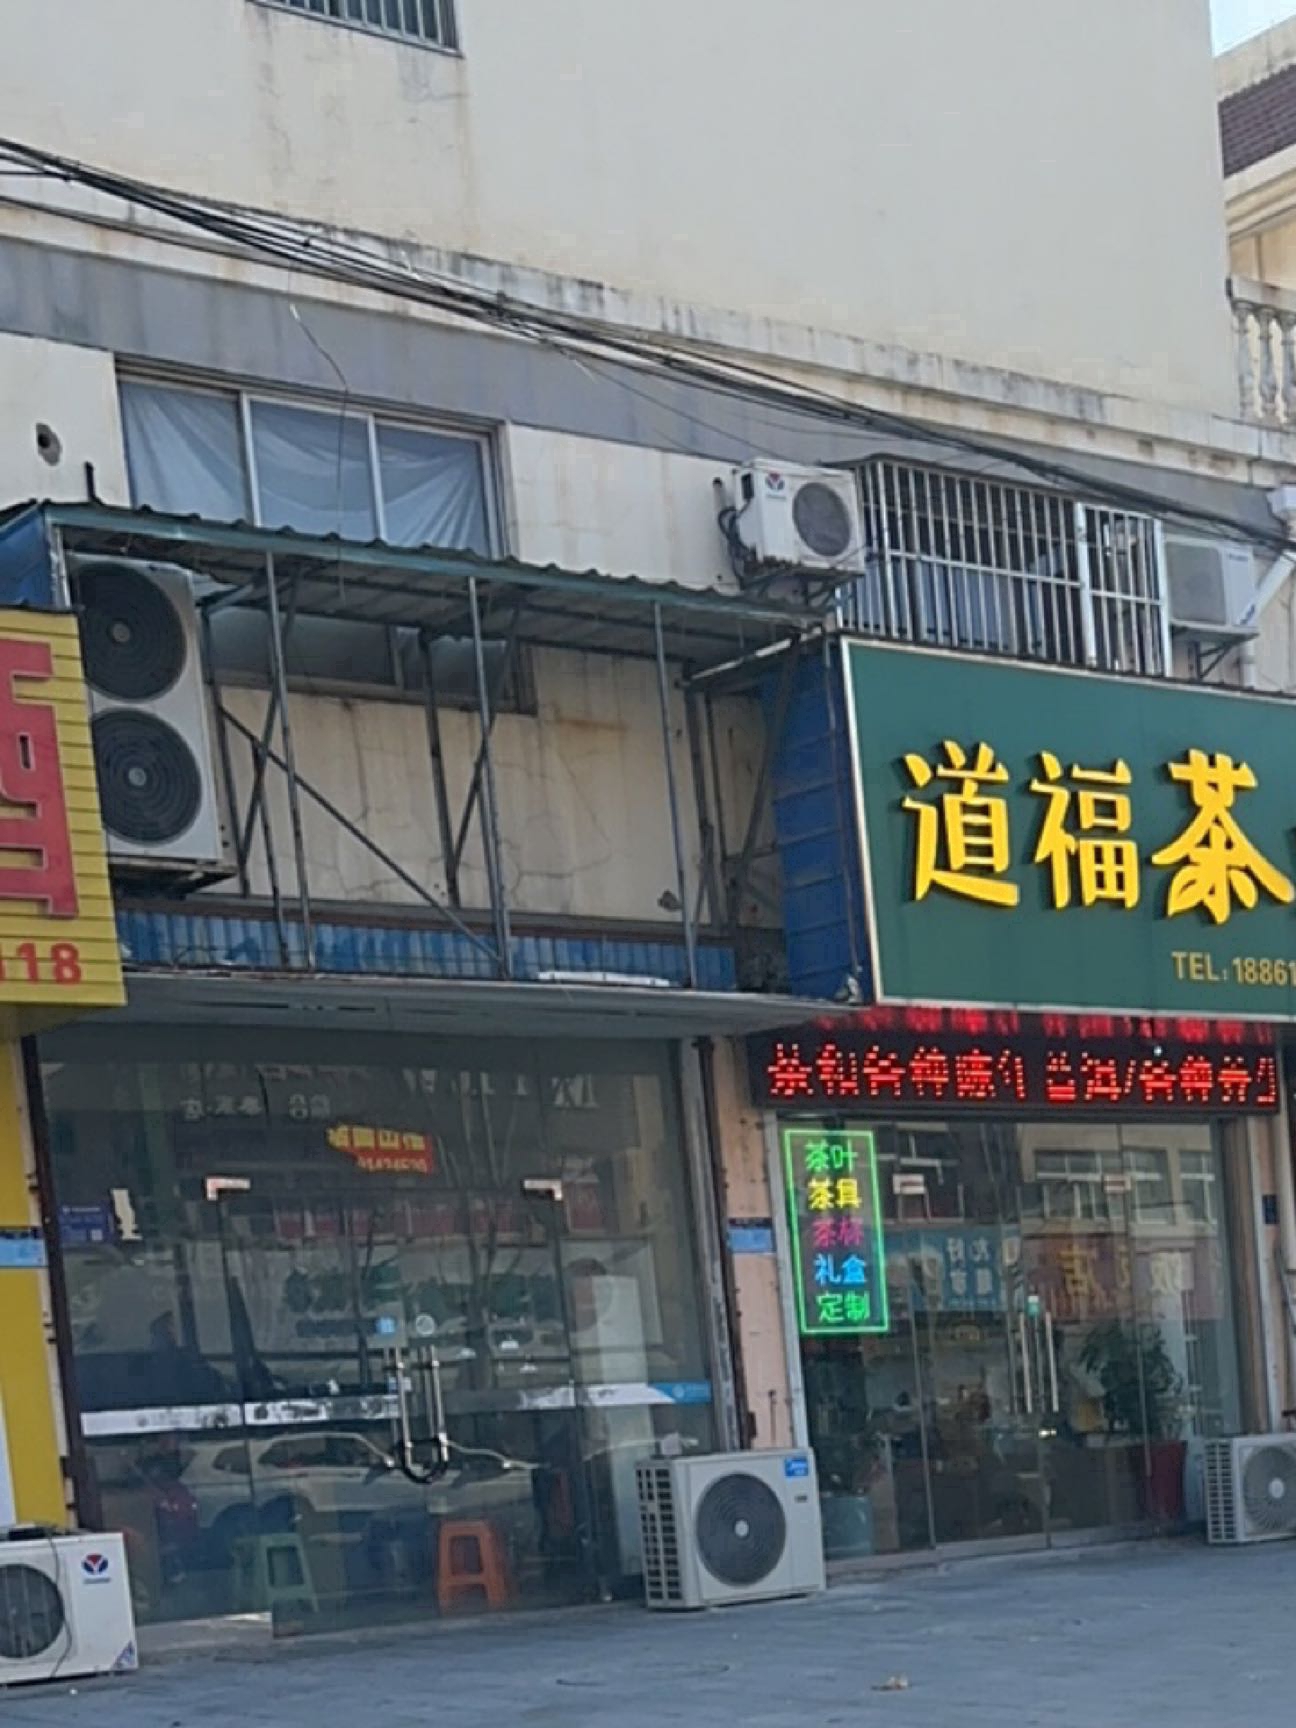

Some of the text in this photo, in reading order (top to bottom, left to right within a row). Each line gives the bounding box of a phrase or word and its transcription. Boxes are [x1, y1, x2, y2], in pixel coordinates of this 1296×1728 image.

[805, 1138, 859, 1172] 茶叶
[807, 1175, 862, 1211] 茶具
[812, 1216, 865, 1248] 茶杯
[813, 1252, 868, 1286] 礼盒
[815, 1290, 871, 1323] 定制
